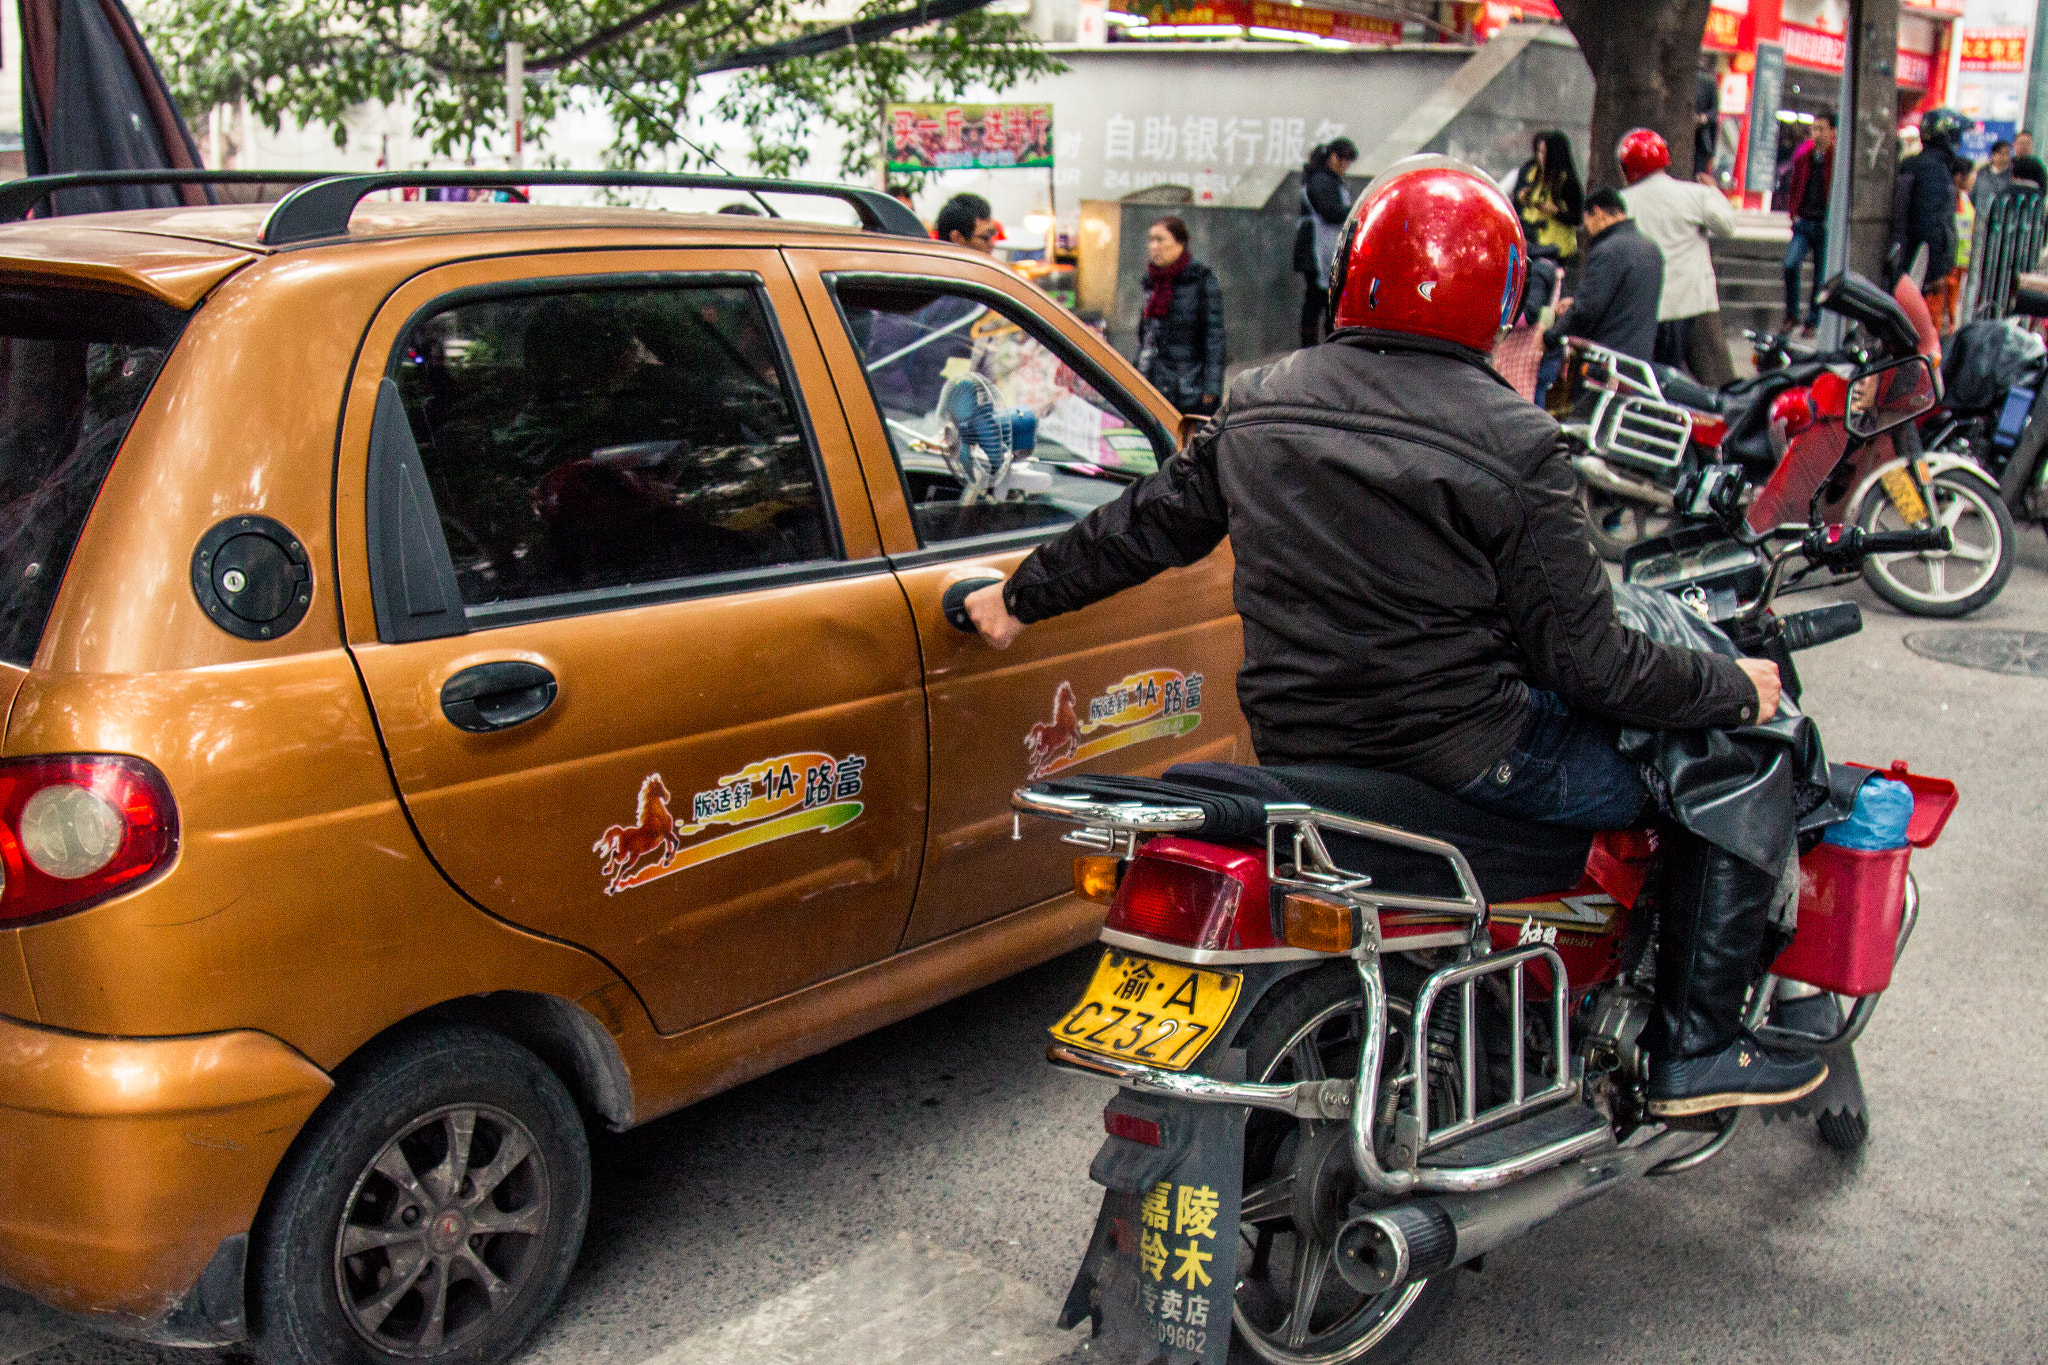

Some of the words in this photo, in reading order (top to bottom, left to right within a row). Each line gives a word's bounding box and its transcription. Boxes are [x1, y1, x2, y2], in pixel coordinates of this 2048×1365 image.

[1062, 1001, 1208, 1062] CZ327
[1142, 1181, 1219, 1239] 嘉陵
[1140, 1229, 1213, 1290] 铃木
